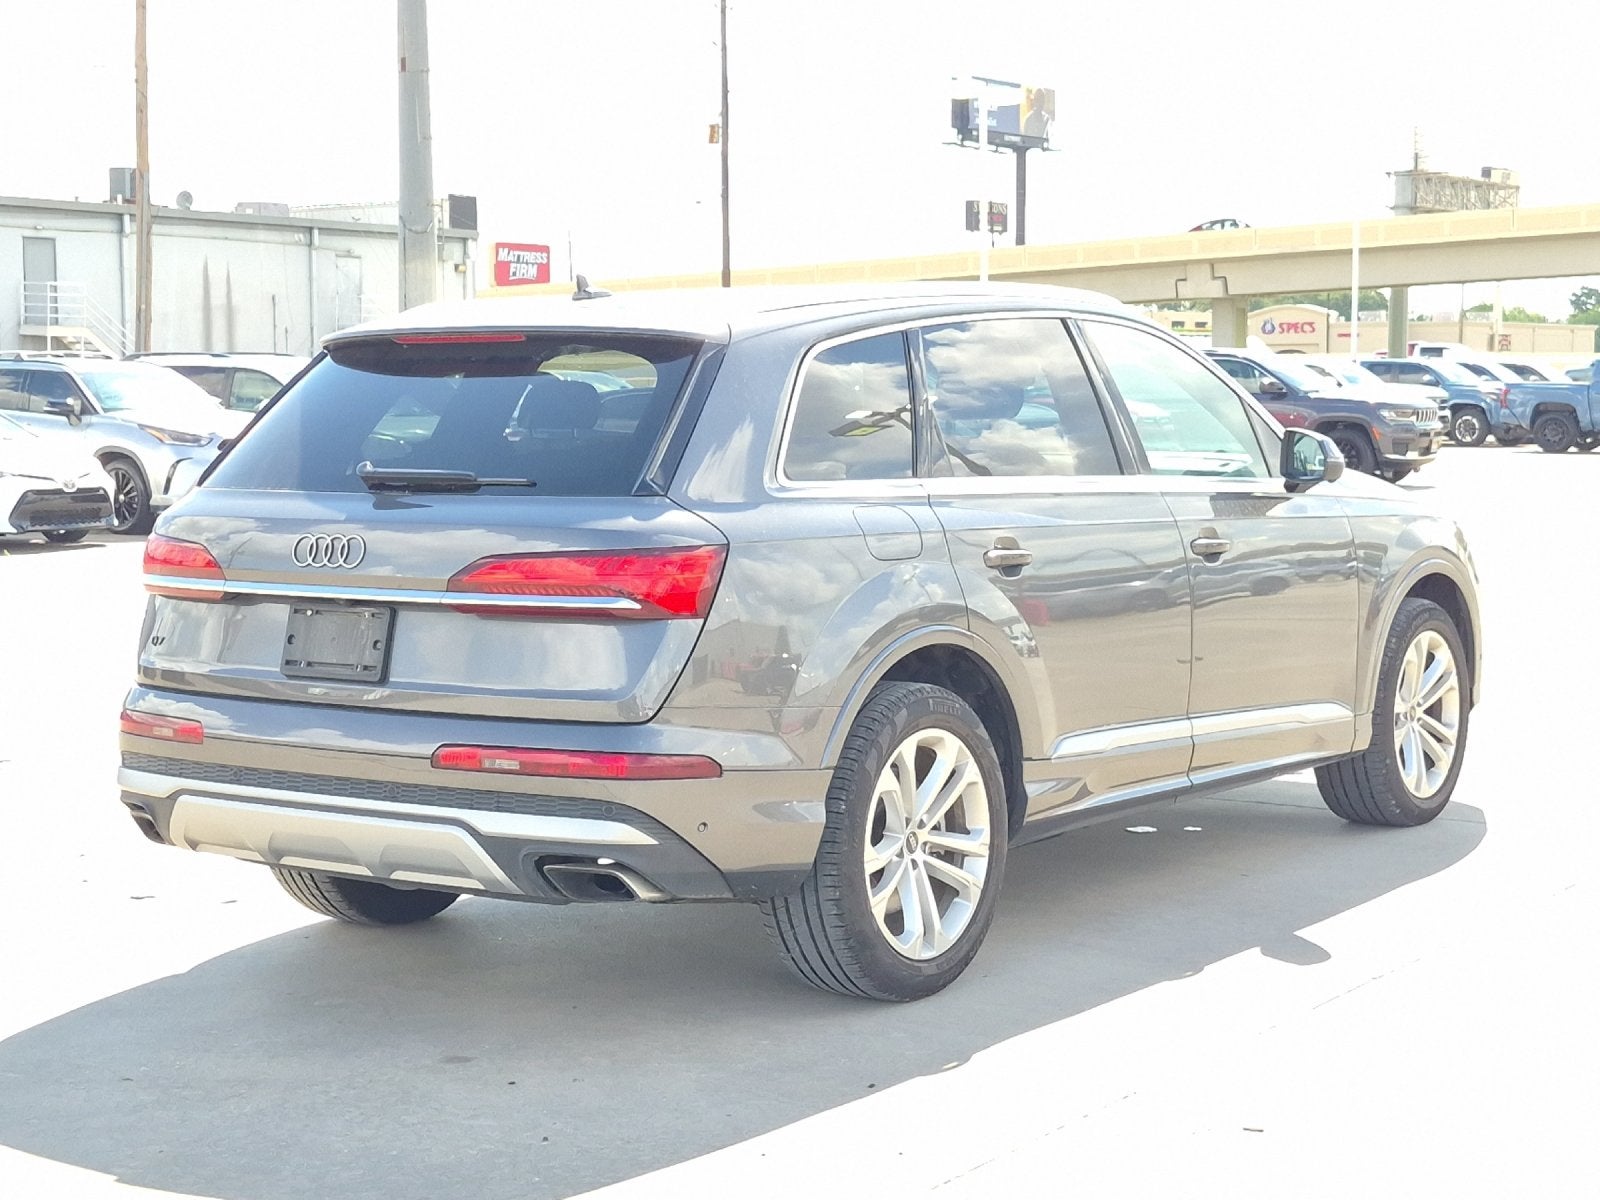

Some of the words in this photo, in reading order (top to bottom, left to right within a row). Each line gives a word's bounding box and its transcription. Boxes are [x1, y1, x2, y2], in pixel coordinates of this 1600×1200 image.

[498, 247, 548, 264] MATTRESS
[509, 263, 538, 278] FIRM
[151, 635, 166, 646] Q7
